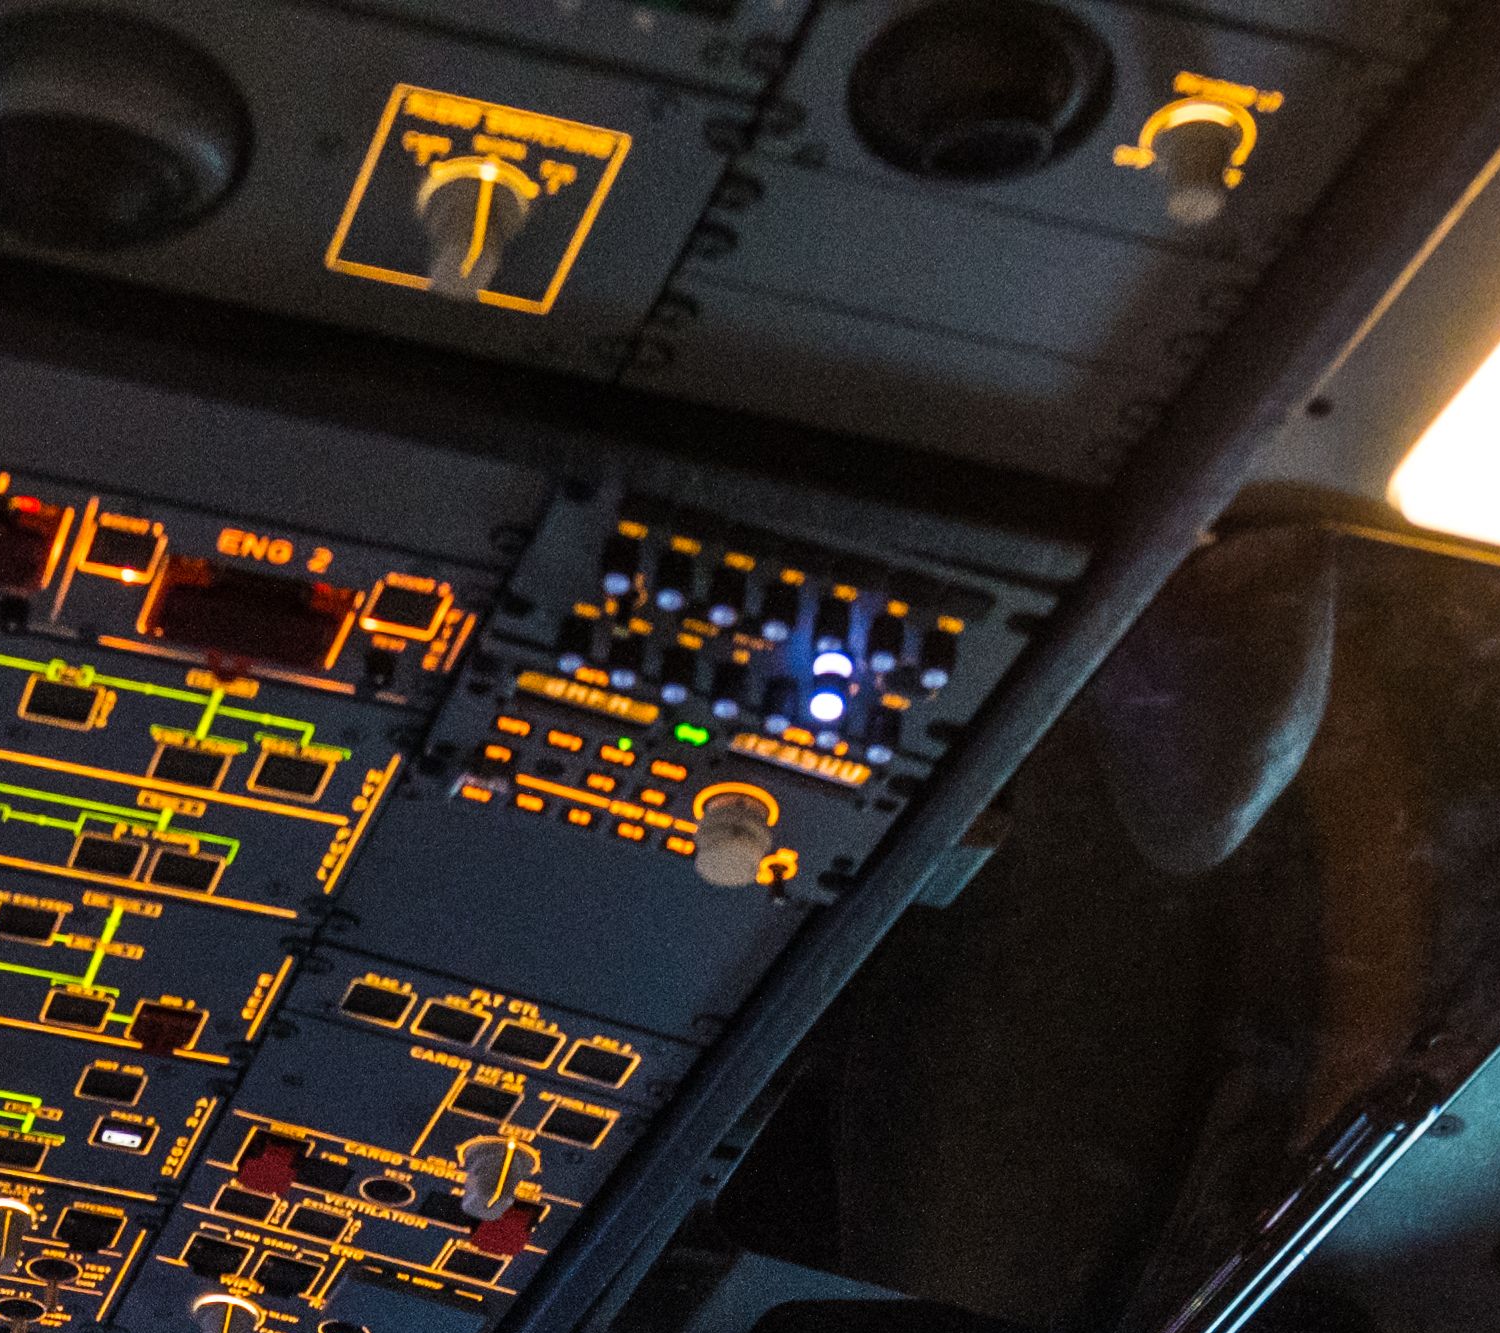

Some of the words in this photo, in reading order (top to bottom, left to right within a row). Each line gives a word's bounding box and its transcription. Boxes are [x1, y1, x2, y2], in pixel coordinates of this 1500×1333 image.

[218, 529, 294, 565] ENG
[307, 548, 333, 573] 2
[410, 1046, 472, 1070] CARGO
[344, 1142, 402, 1165] CARGO
[325, 1193, 428, 1229] VENTILATION
